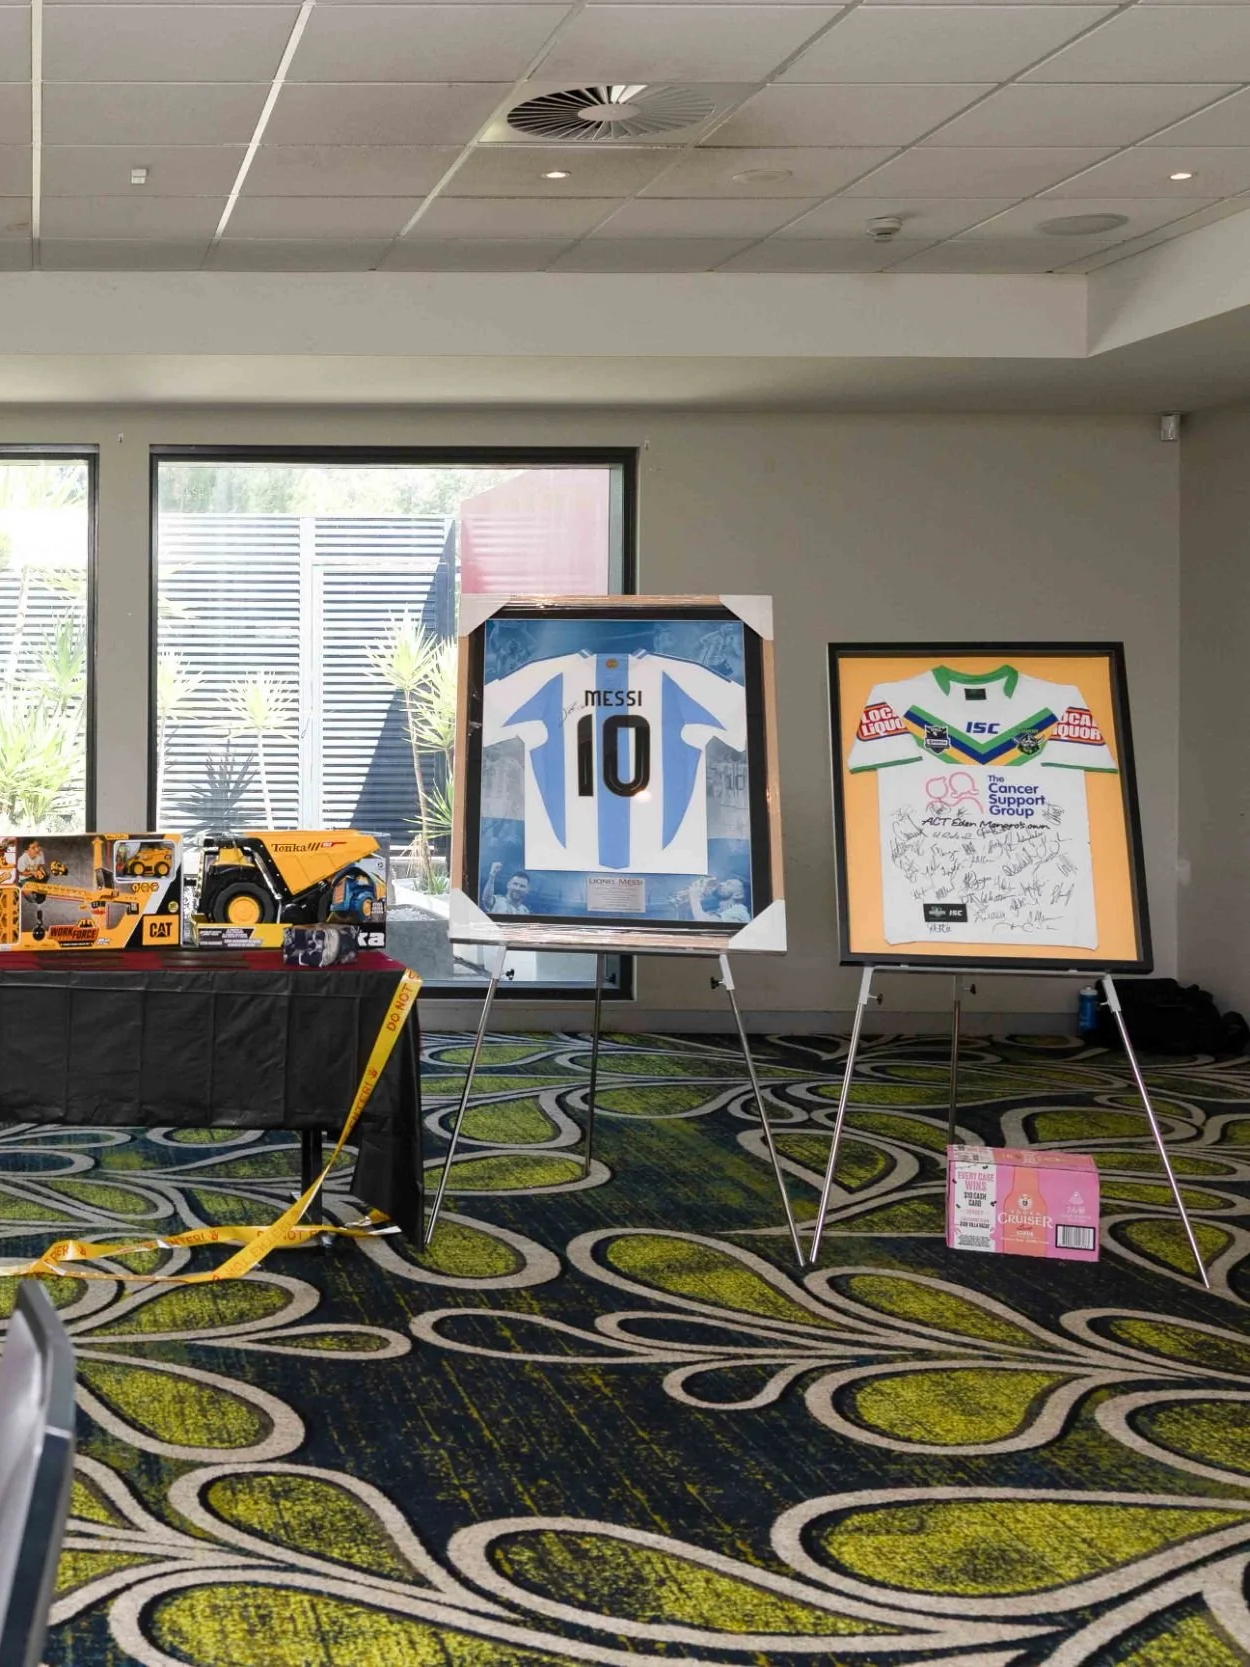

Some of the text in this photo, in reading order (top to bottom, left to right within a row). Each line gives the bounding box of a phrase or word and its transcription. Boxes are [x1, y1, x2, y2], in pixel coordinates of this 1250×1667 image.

[585, 690, 642, 706] MESSI
[862, 707, 897, 724] LOC
[966, 721, 1000, 734] ISC
[577, 714, 650, 797] 10
[989, 783, 1038, 794] Cancer
[989, 794, 1045, 807] Support
[989, 805, 1034, 818] Group
[922, 817, 951, 826] ACT
[951, 817, 977, 827] Eden
[271, 843, 306, 852] Tonka
[50, 926, 97, 940] WORK FORCE
[150, 922, 173, 938] CAT
[386, 1013, 400, 1031] DO
[398, 983, 414, 1011] NOT
[957, 1171, 978, 1180] EVERY
[965, 1180, 987, 1191] WINS
[997, 1212, 1054, 1229] CRUISER
